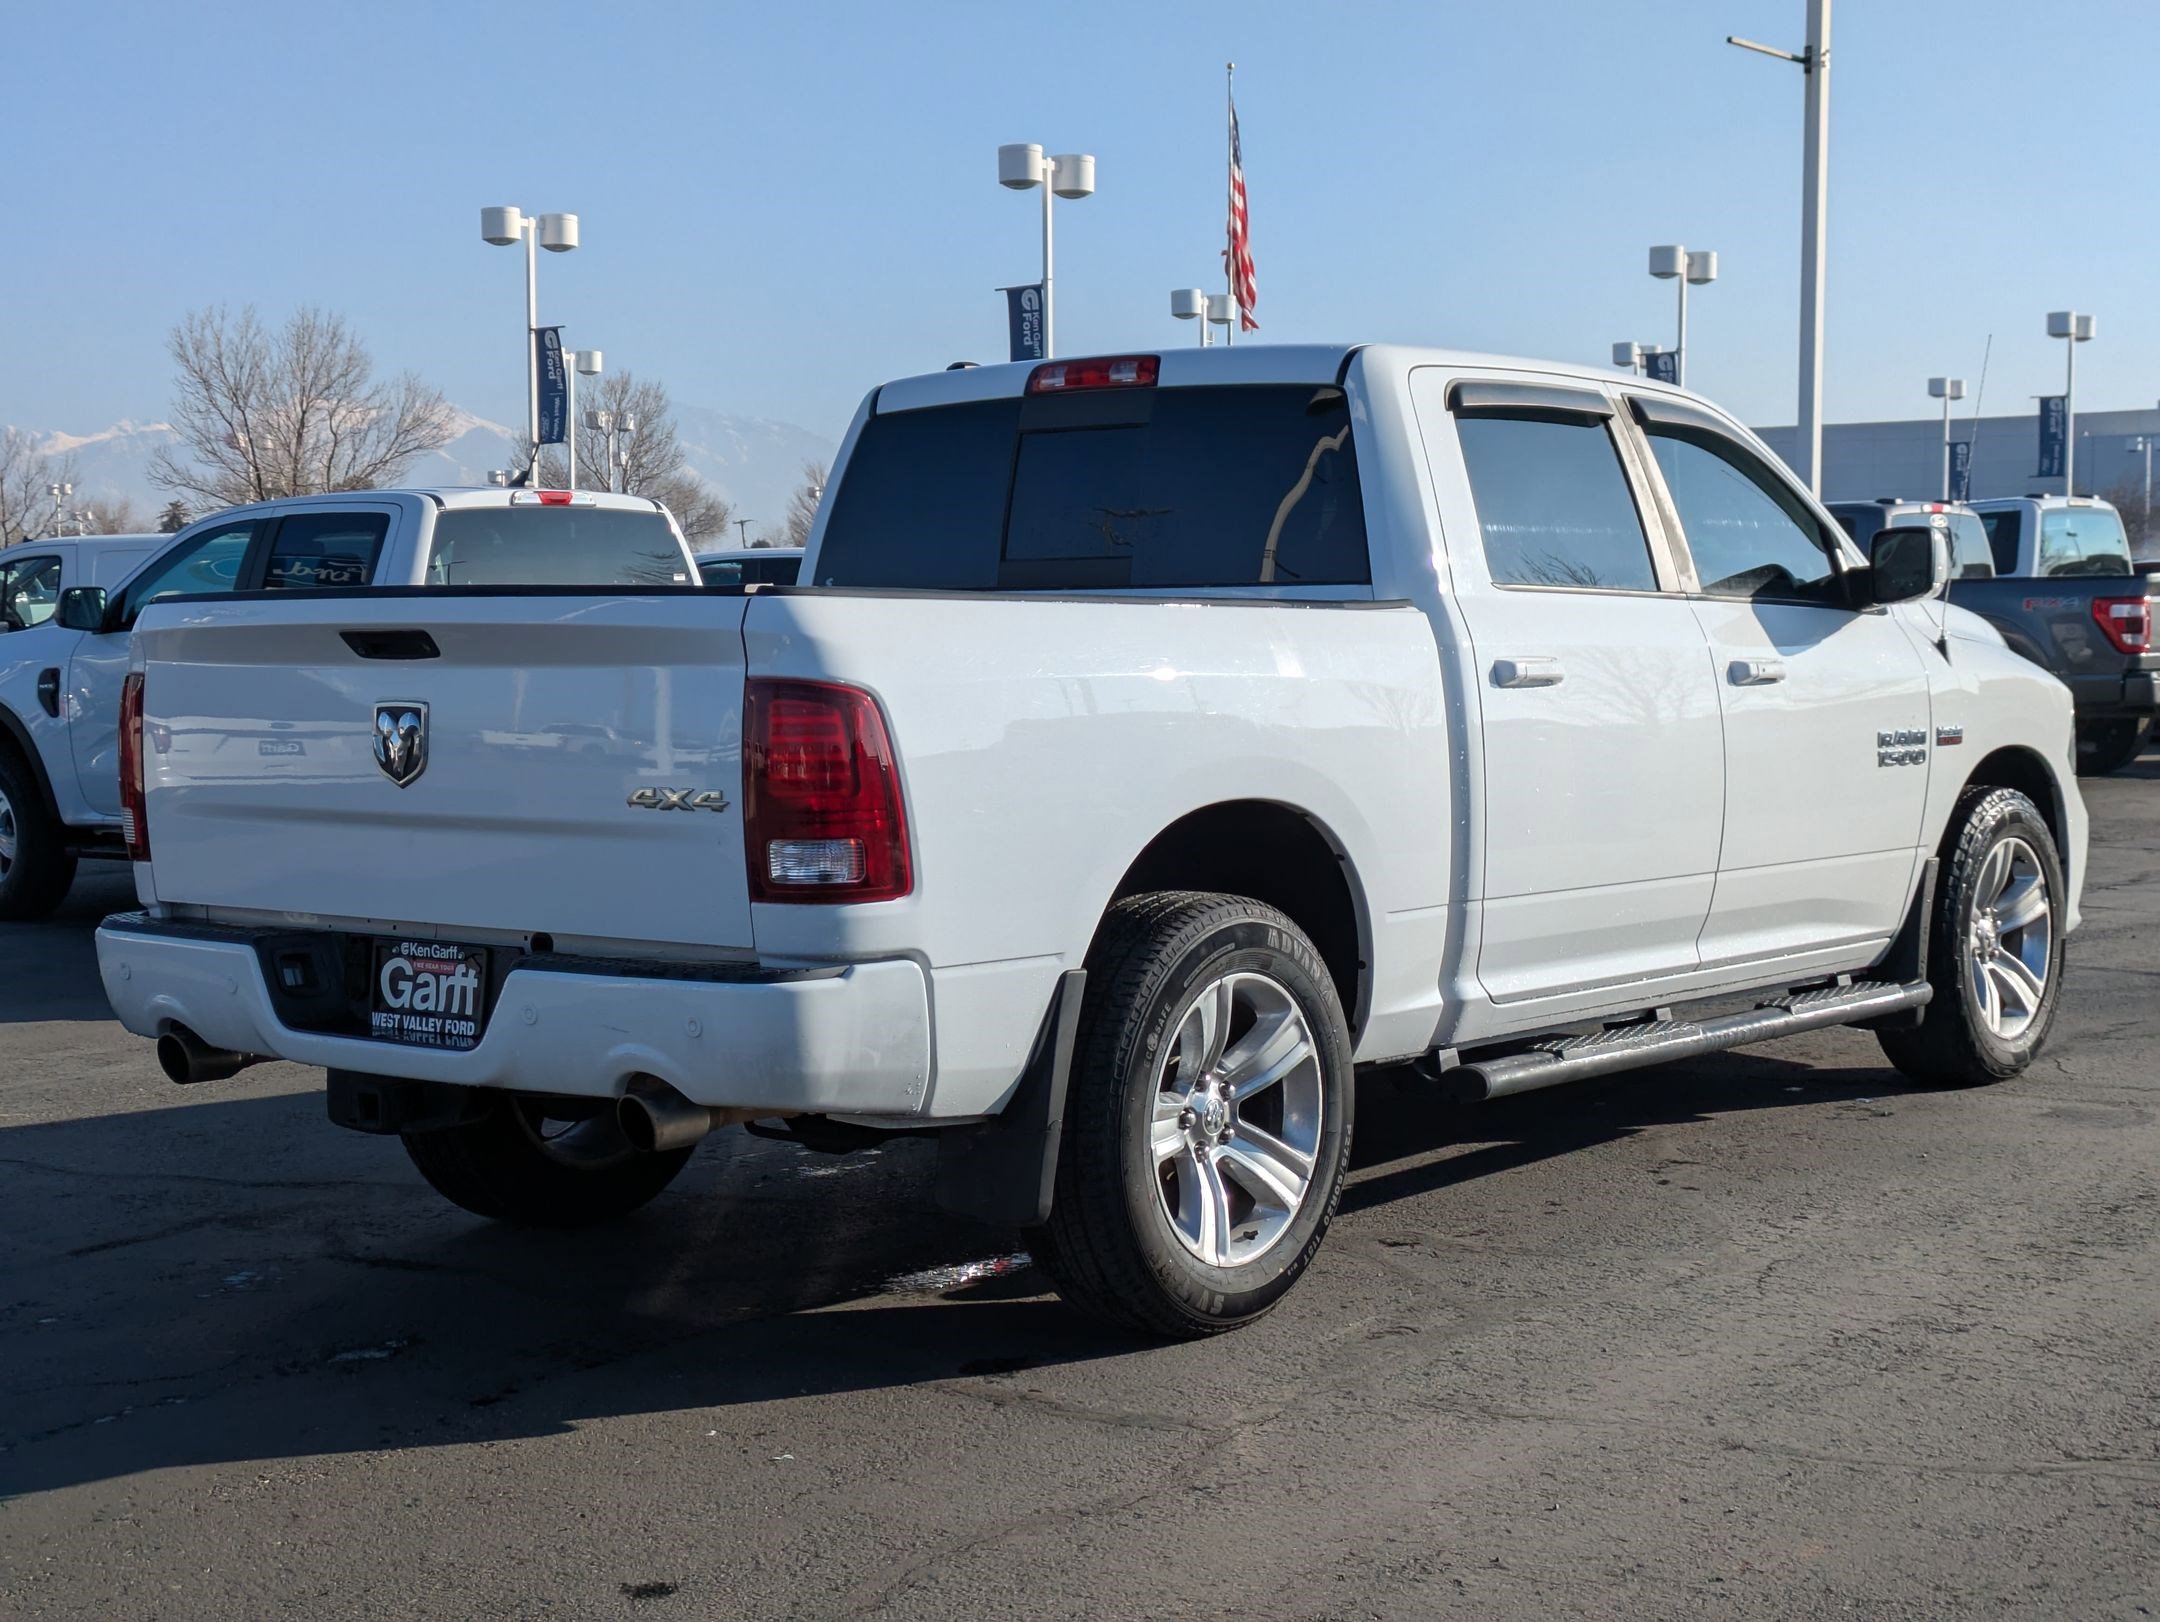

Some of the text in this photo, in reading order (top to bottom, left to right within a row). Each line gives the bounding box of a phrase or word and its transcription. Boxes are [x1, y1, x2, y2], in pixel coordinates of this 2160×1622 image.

[1022, 312, 1033, 346] Ford
[546, 350, 557, 380] Ford
[1877, 728, 1927, 748] RAM
[1877, 748, 1927, 768] 1500
[410, 943, 430, 957] Ken
[431, 944, 458, 960] Garff
[372, 1011, 475, 1036] WEST VALLEY FORD
